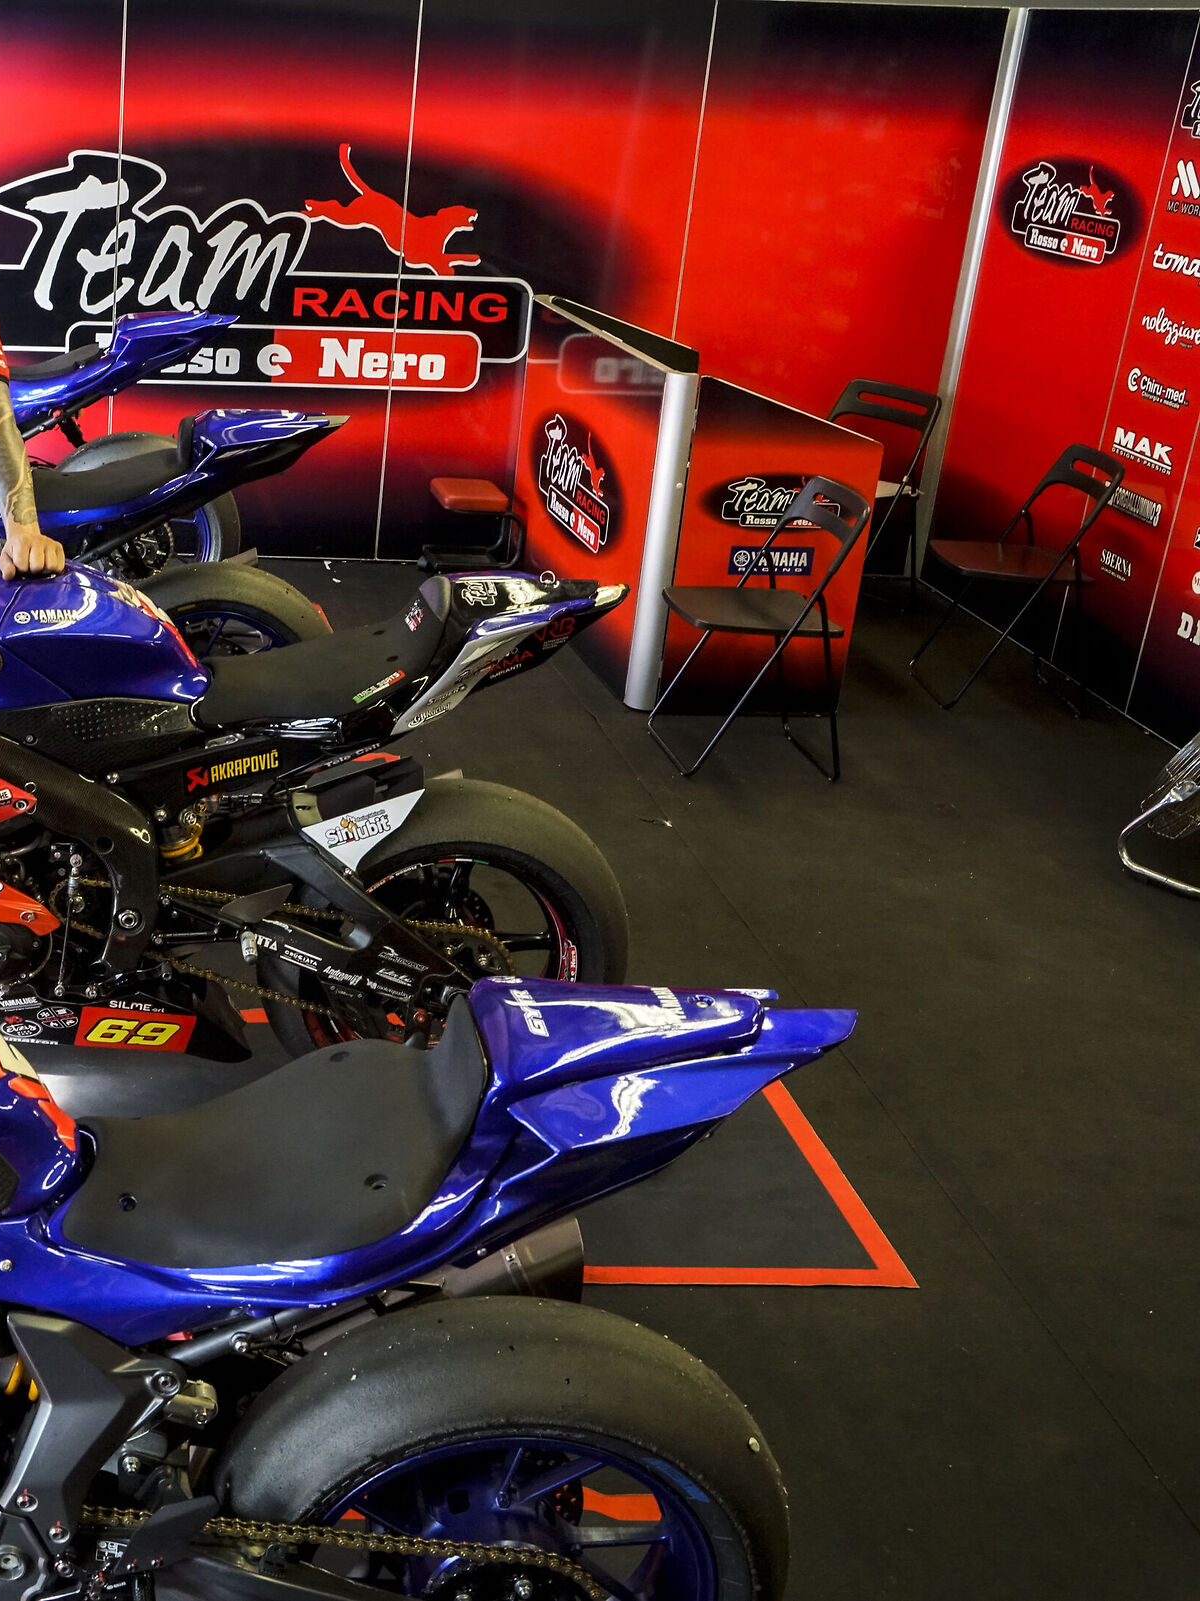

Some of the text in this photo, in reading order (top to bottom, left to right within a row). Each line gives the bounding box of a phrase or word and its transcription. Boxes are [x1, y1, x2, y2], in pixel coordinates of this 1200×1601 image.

[1028, 171, 1080, 226] Team
[1166, 201, 1180, 213] MC
[26, 175, 292, 312] Team
[1029, 228, 1100, 260] Rosso e Nero
[1070, 218, 1115, 239] RACING
[293, 286, 508, 322] RACING
[257, 338, 446, 381] e Nero
[1140, 375, 1186, 405] Chiru-med
[546, 425, 582, 498] Team
[1112, 447, 1135, 461] DESIGN
[1143, 460, 1171, 476] PASSION
[1114, 426, 1173, 467] MAK
[576, 491, 606, 526] RACING
[730, 482, 796, 513] Team
[550, 491, 570, 522] Rosso
[576, 514, 596, 546] Nero
[745, 515, 778, 526] Rosso
[751, 550, 808, 567] YAMAHA
[1100, 548, 1132, 577] SBERNA
[30, 609, 79, 621] YAMAHA
[210, 749, 280, 783] AKRAPOVIČ
[109, 999, 152, 1012] SILME
[86, 1017, 181, 1047] 69
